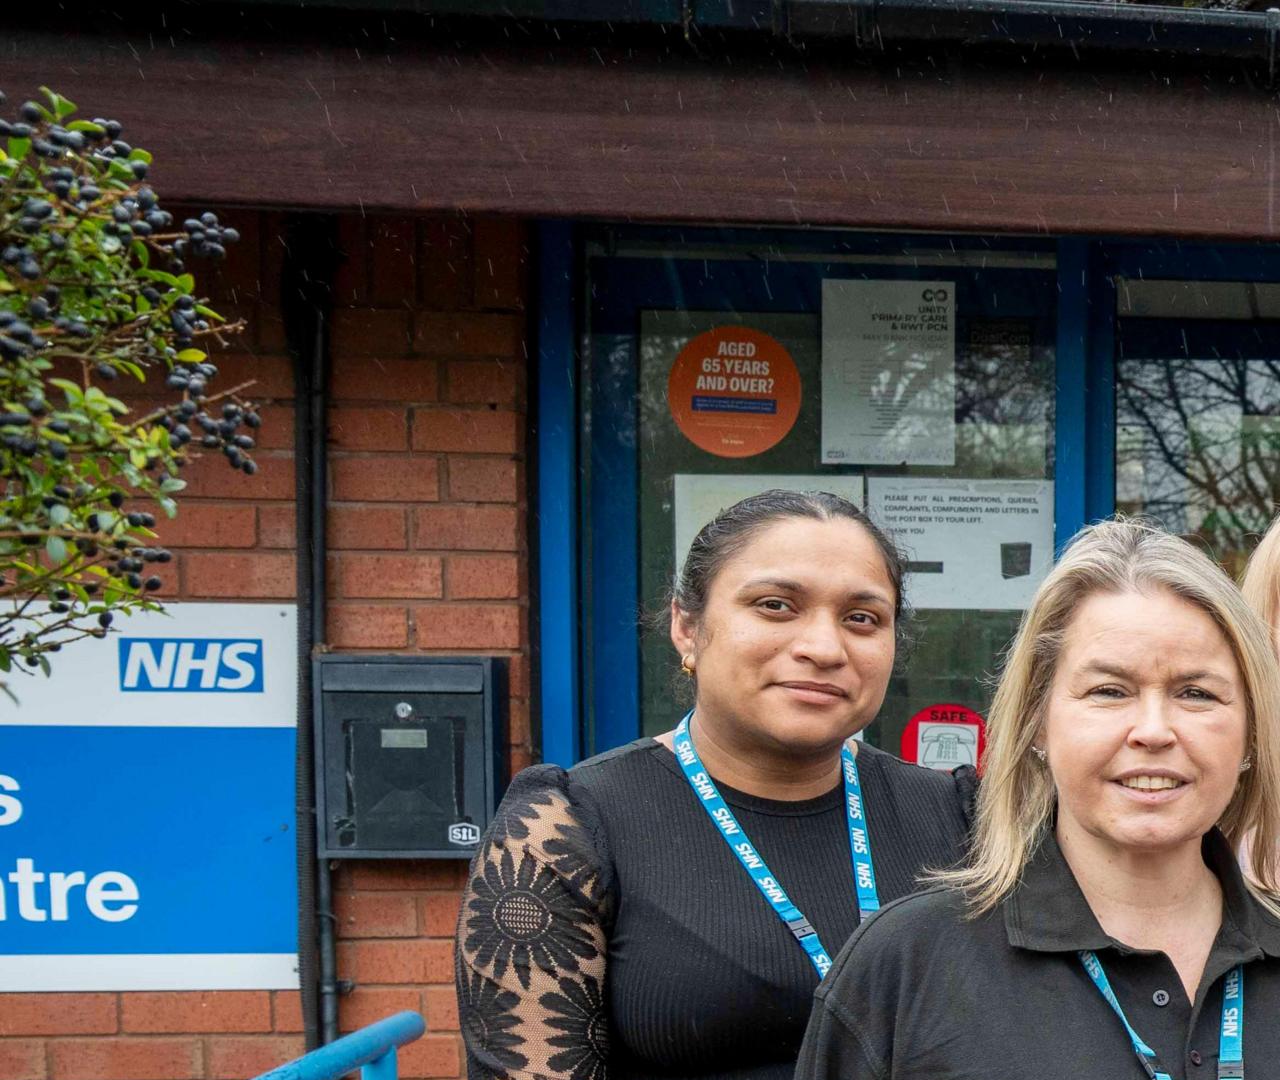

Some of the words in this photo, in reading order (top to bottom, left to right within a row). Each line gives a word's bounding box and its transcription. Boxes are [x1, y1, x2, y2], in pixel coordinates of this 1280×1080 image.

[718, 341, 756, 357] AGED
[702, 358, 720, 373] 65
[723, 360, 770, 376] YEARS
[696, 375, 728, 391] AND
[730, 377, 775, 394] OVER?
[918, 516, 932, 524] BOX
[123, 641, 258, 689] NHS
[930, 710, 968, 722] SAFE
[677, 741, 697, 766] NHS
[844, 757, 858, 787] NHS
[691, 772, 718, 801] NHS
[848, 792, 862, 820] NHS
[712, 807, 740, 836] NHS
[851, 827, 868, 855] NHS
[734, 842, 763, 869] NHS
[0, 858, 140, 922] tre
[758, 876, 787, 903] NHS
[856, 862, 874, 890] NHS
[1222, 1007, 1239, 1038] NHS
